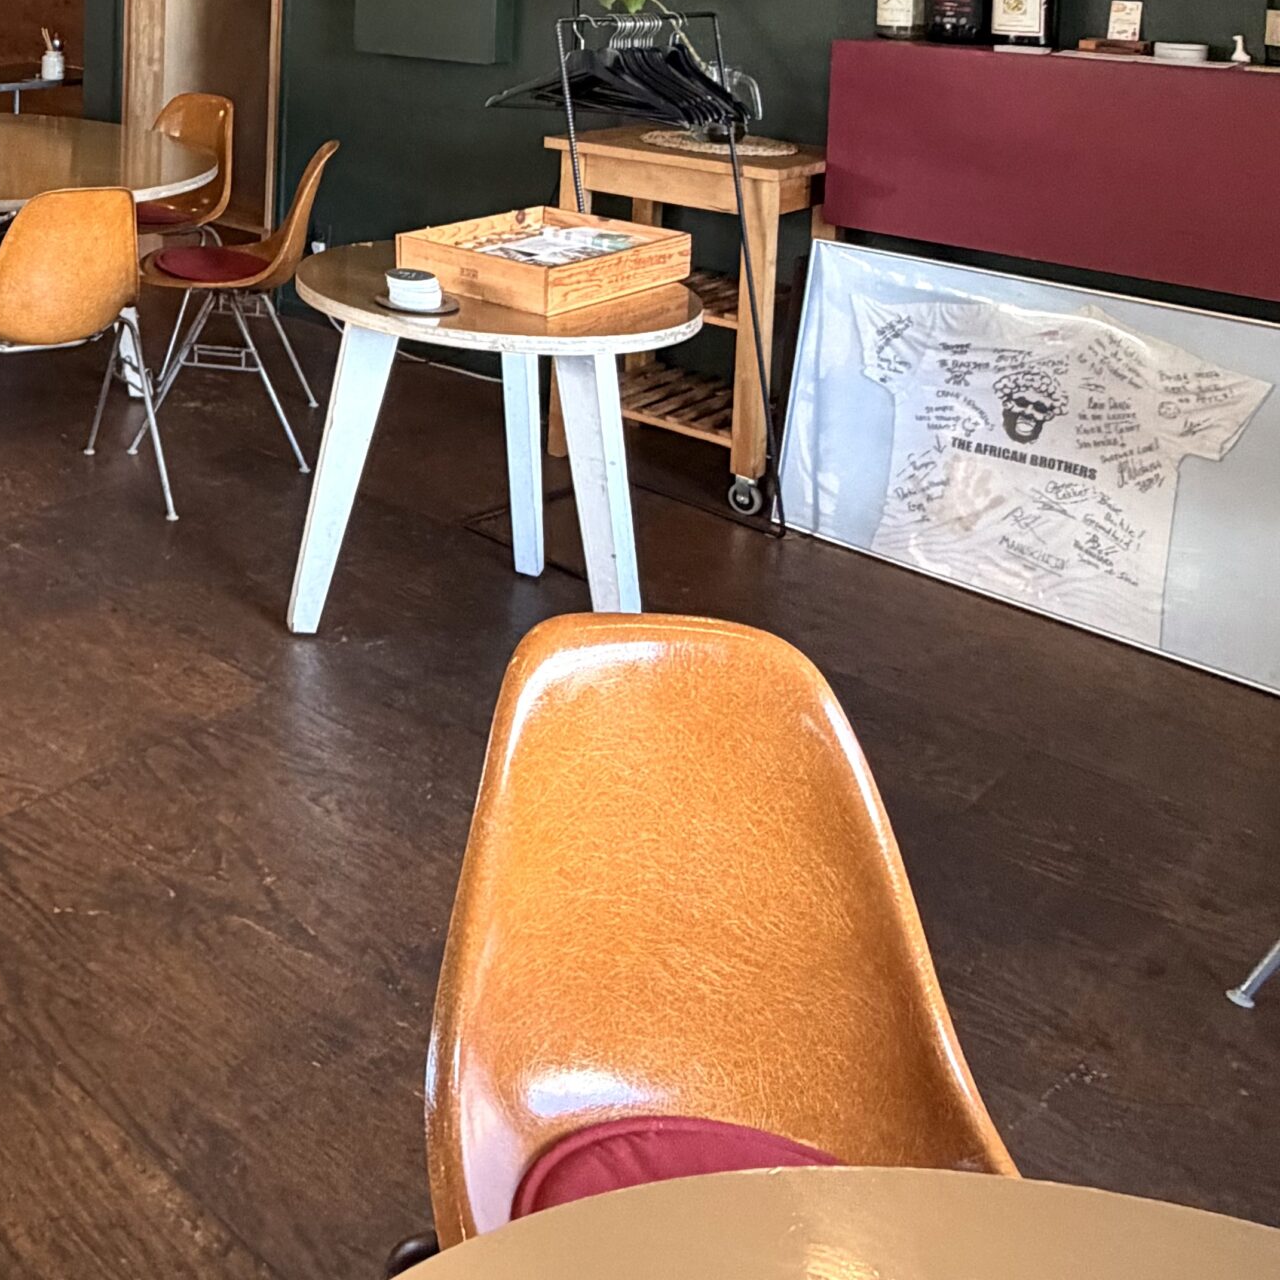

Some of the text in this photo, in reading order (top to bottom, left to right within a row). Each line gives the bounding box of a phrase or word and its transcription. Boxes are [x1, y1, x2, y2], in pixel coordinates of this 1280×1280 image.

[951, 436, 972, 453] THE
[974, 442, 1027, 464] AFRICAN
[1029, 454, 1097, 481] BROTHERS
